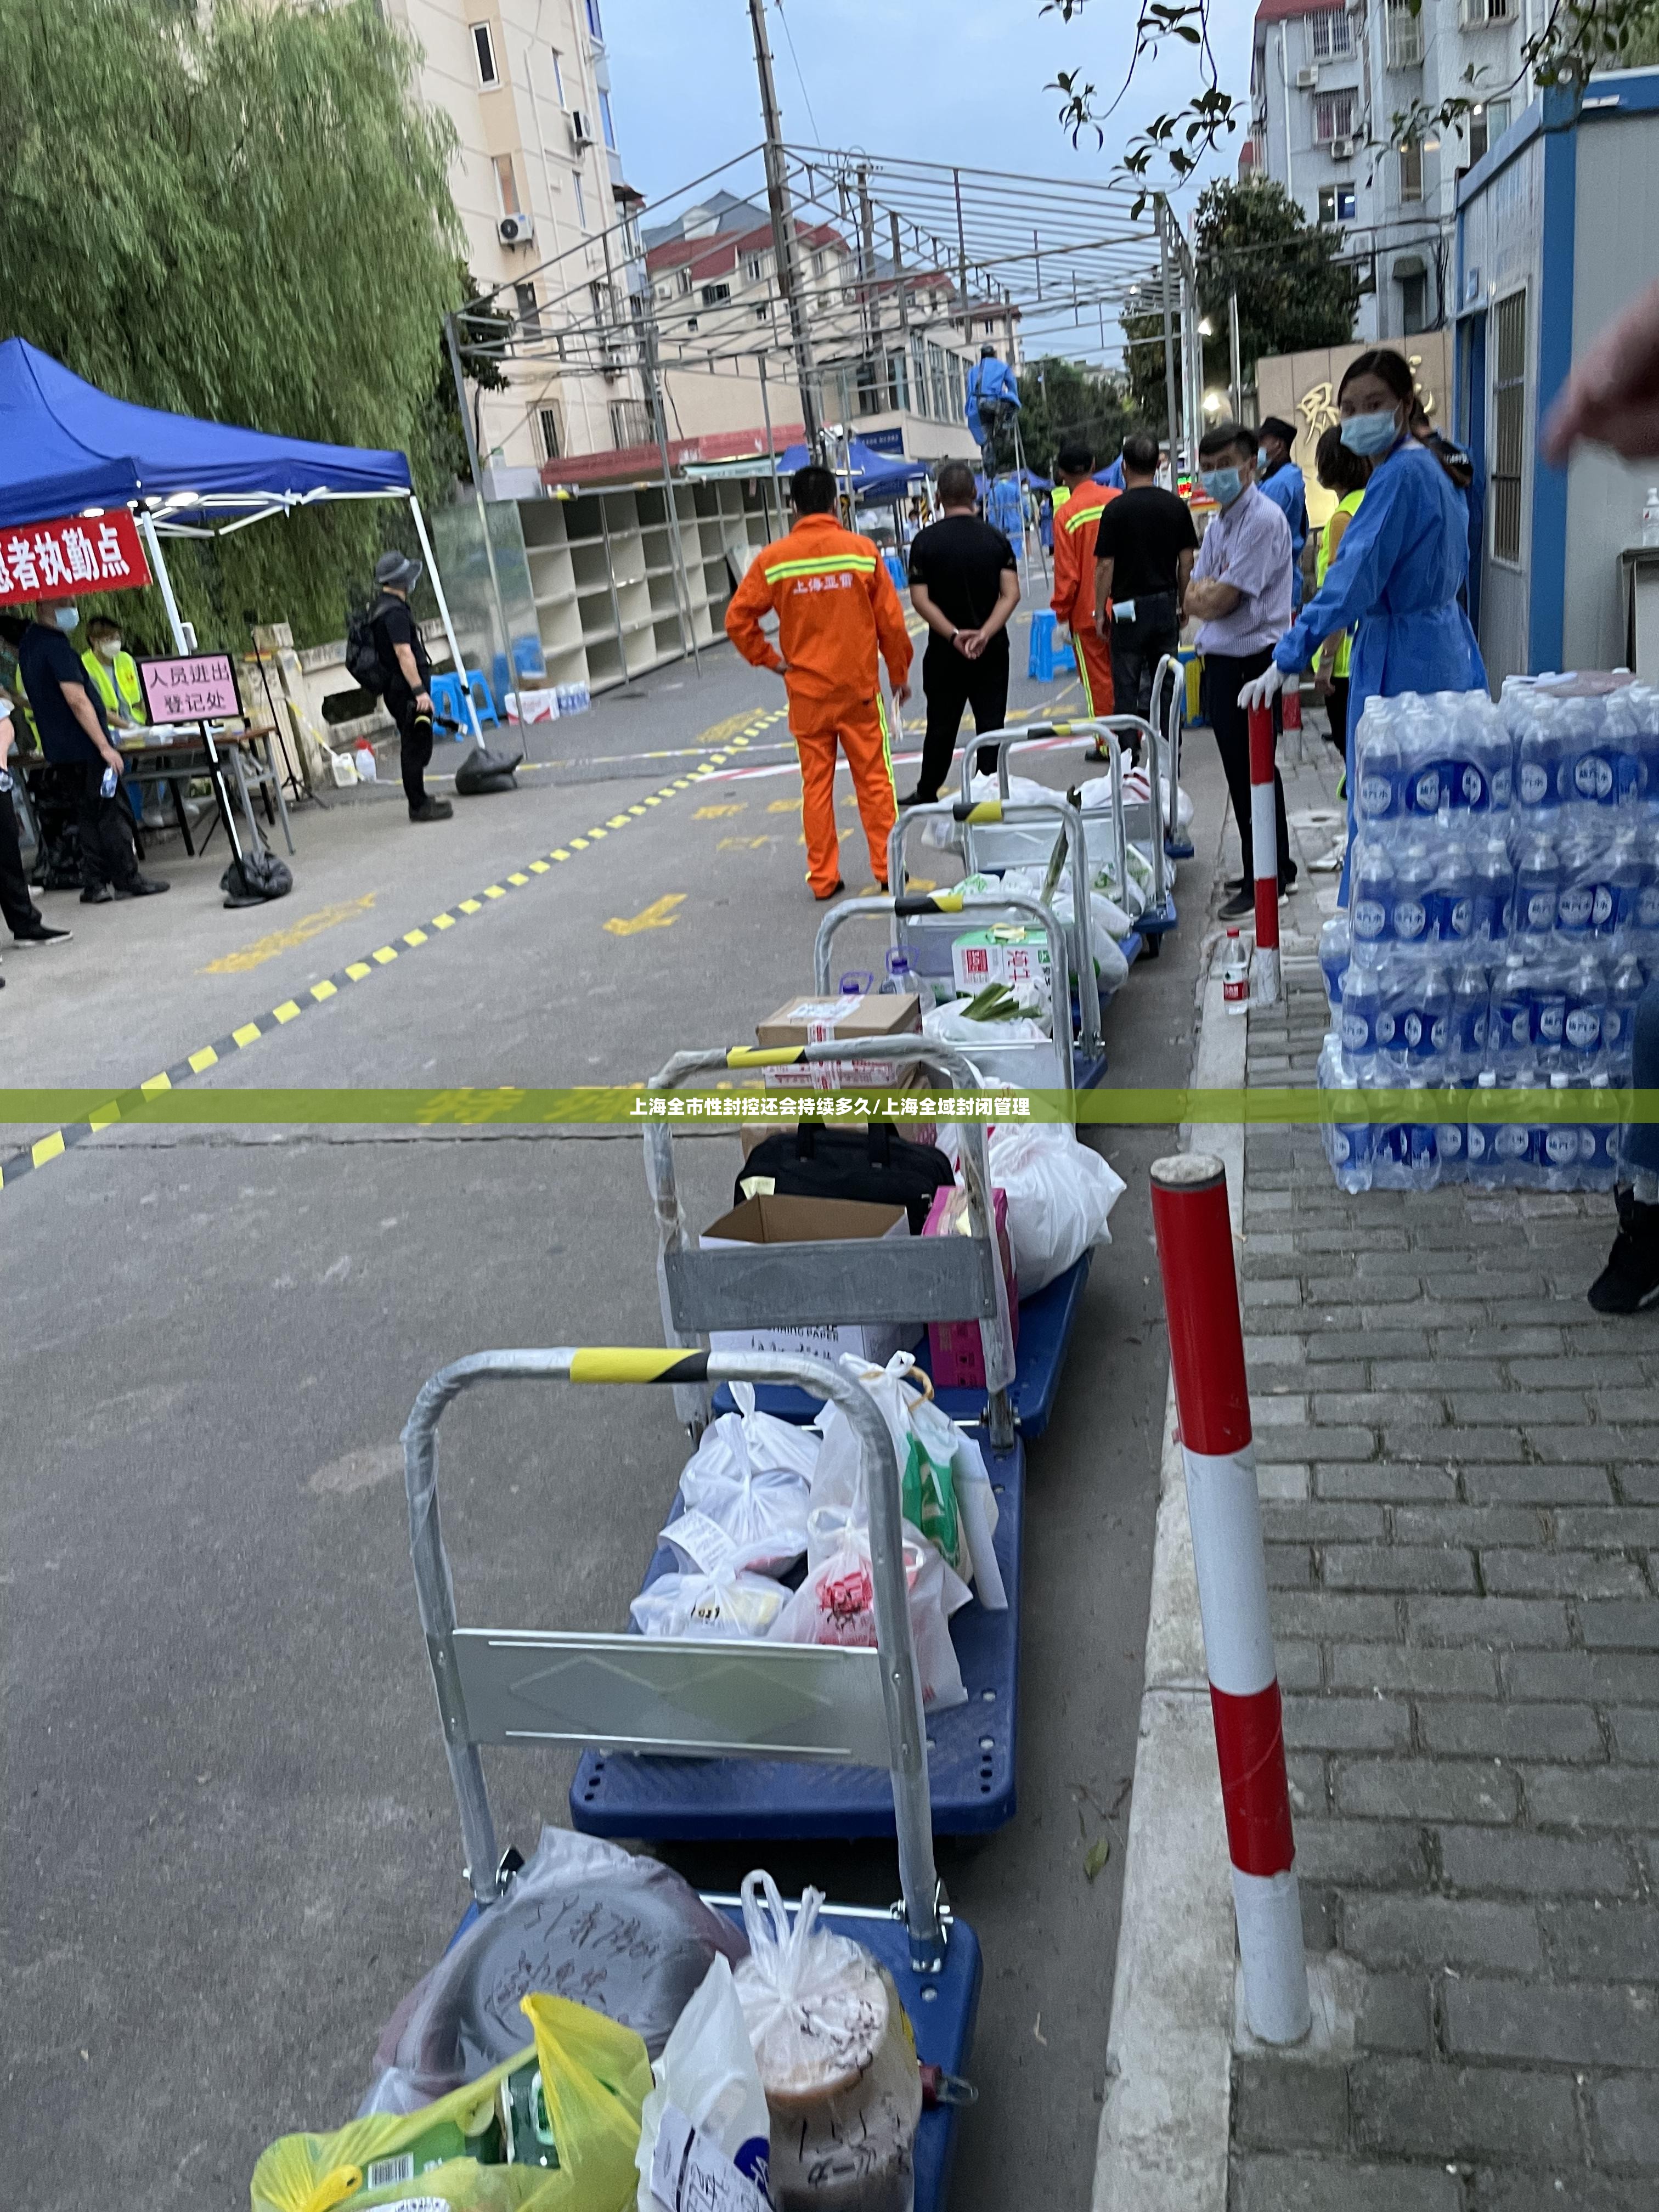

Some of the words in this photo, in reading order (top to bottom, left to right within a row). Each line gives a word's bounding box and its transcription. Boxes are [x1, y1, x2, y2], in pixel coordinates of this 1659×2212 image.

[150, 661, 230, 689] 人员进出
[163, 689, 226, 715] 登记处
